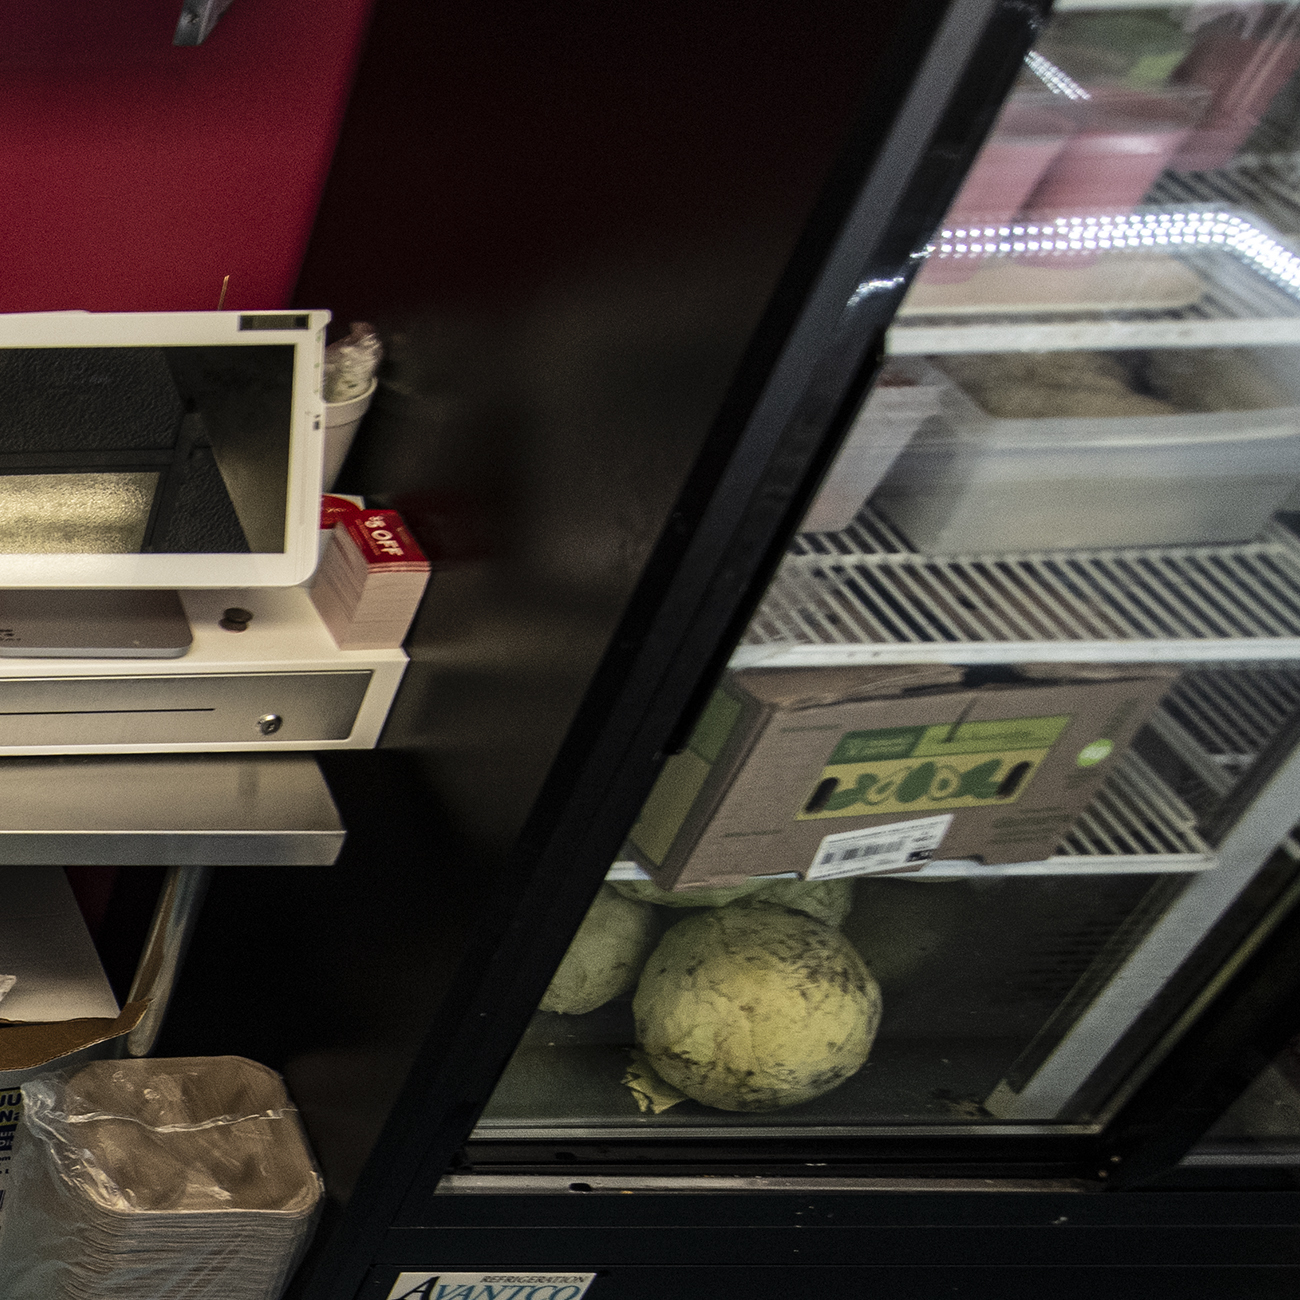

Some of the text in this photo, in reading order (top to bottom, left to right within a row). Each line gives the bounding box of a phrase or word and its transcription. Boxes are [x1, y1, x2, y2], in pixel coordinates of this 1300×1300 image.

[371, 529, 404, 556] OFF
[0, 1108, 20, 1123] Na
[480, 1275, 588, 1284] REFRIGERATION
